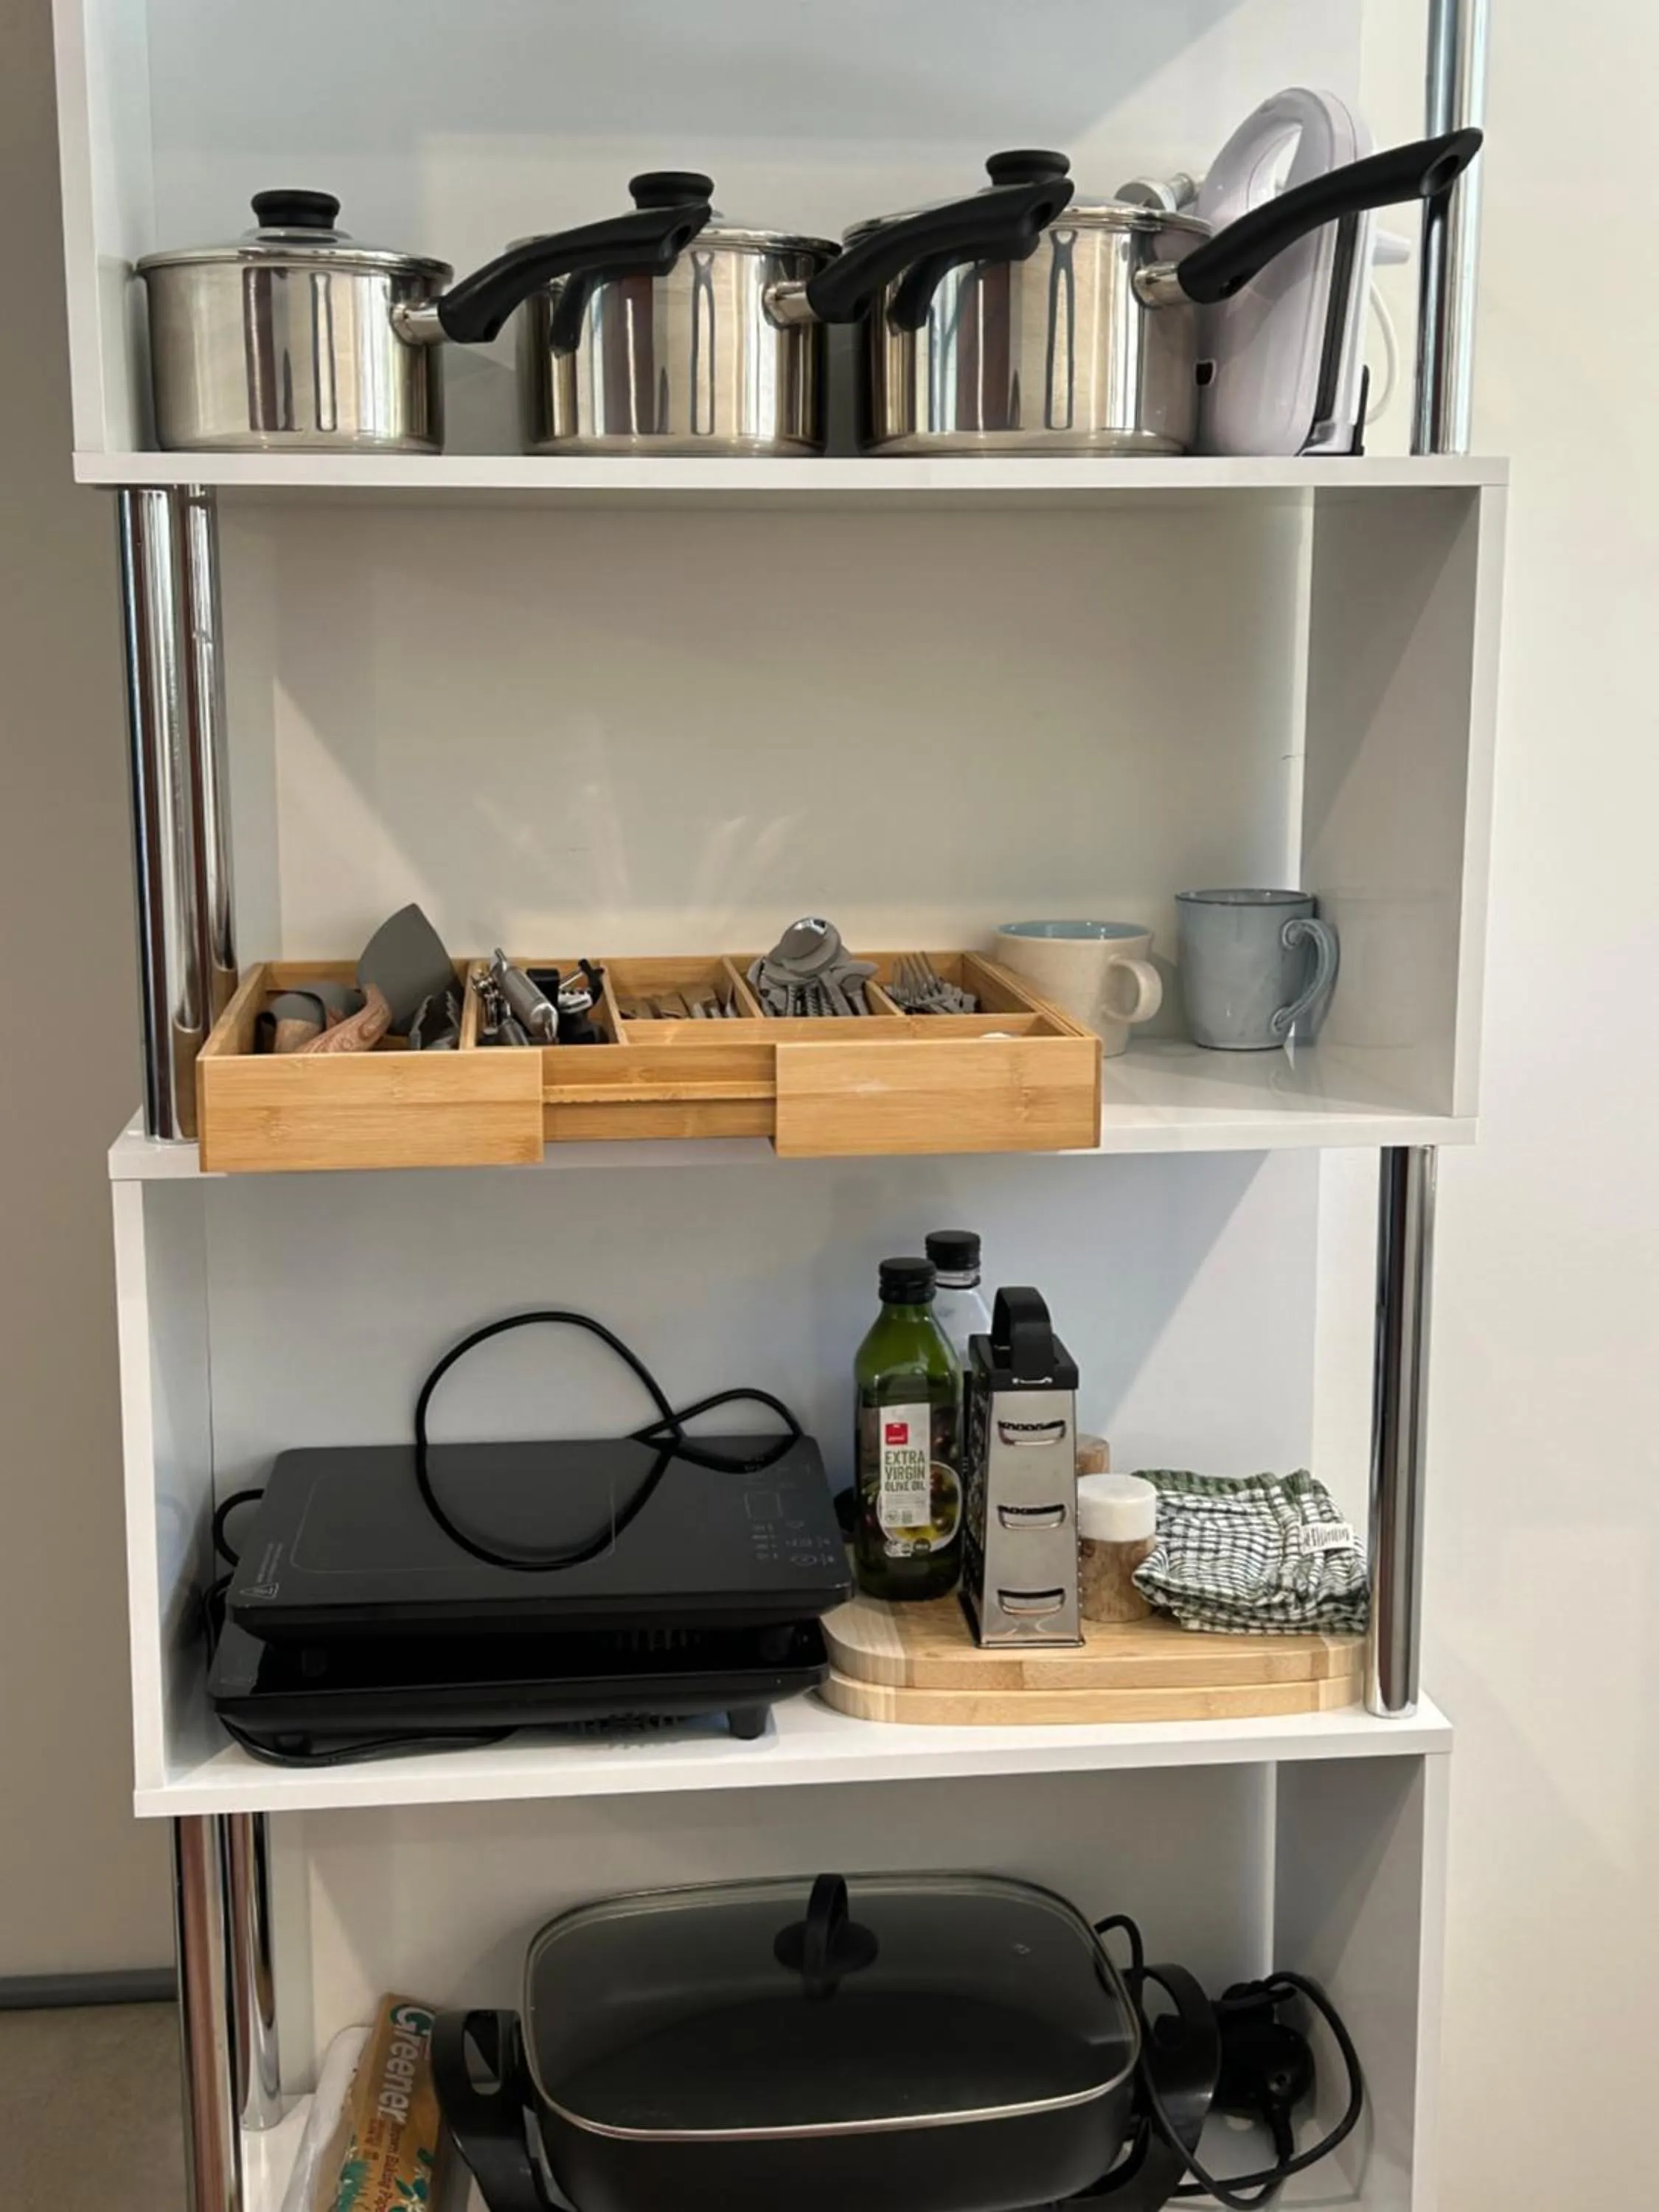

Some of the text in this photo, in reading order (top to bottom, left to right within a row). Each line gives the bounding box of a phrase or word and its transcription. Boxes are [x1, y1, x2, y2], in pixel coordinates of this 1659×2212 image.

[884, 1450, 925, 1465] EXTRA
[884, 1465, 925, 1481] VIRGIN
[884, 1481, 926, 1492] OLIVE OIL
[378, 2006, 436, 2126] Greener
